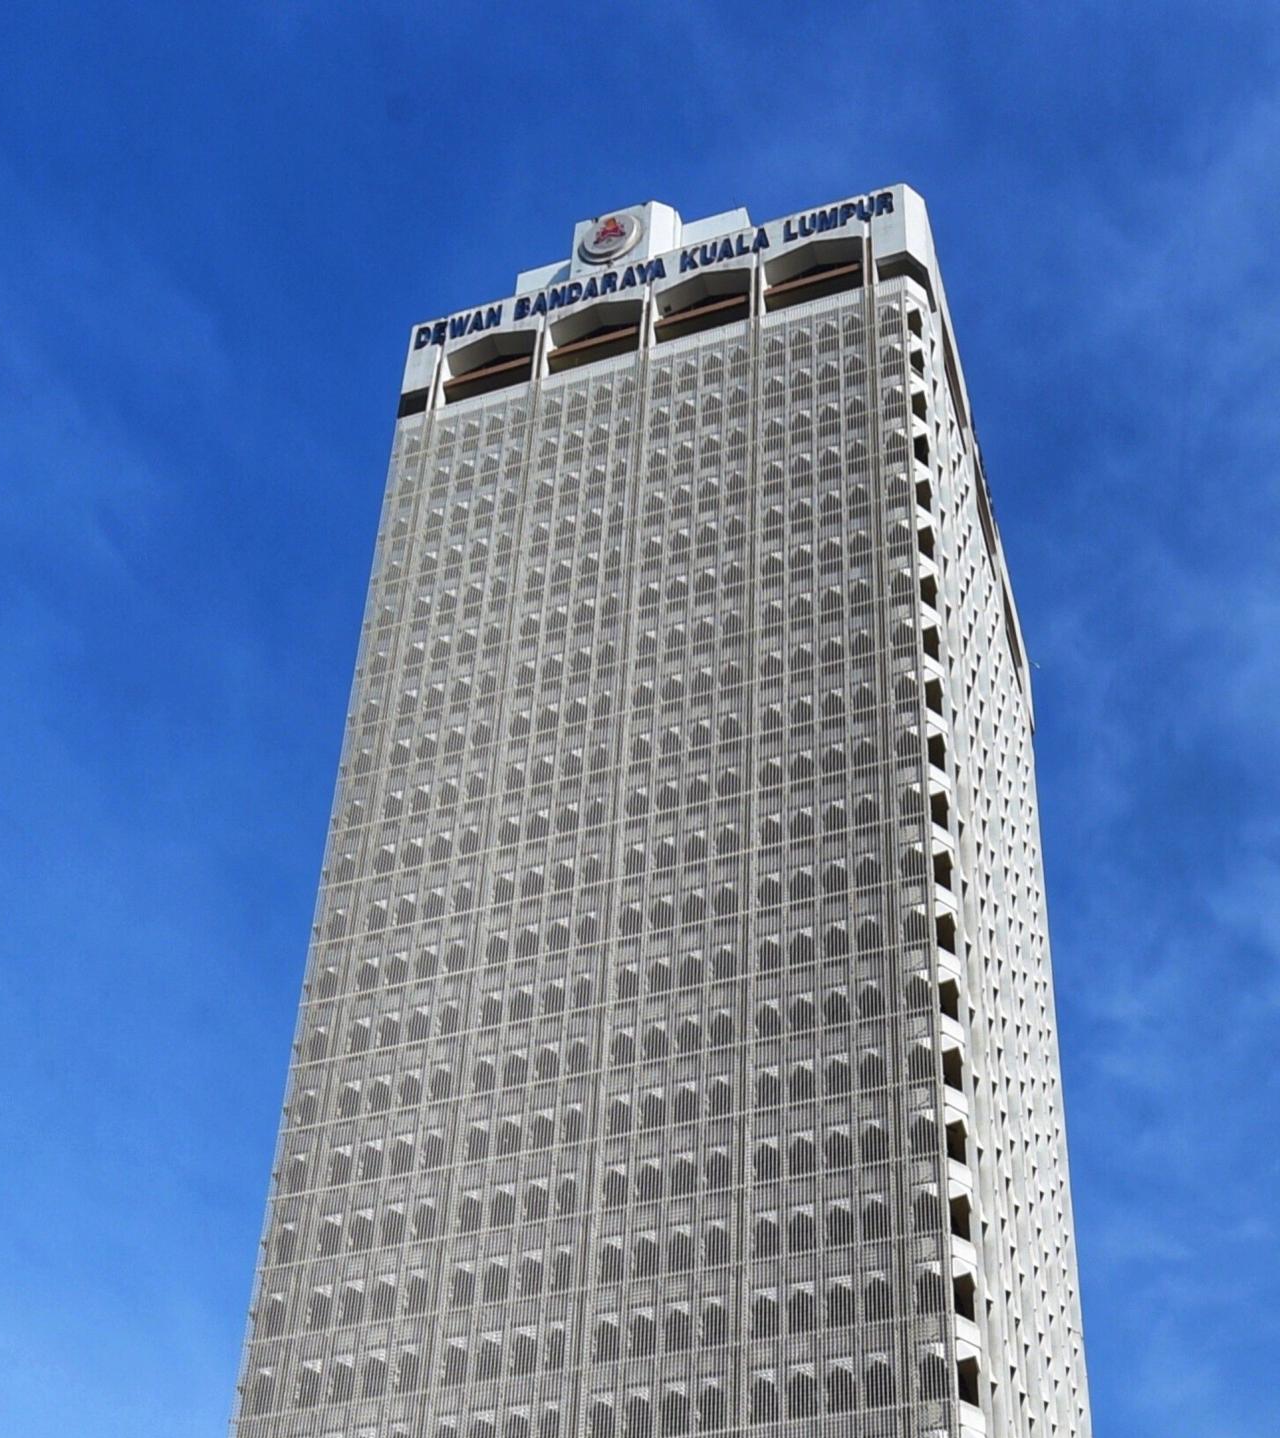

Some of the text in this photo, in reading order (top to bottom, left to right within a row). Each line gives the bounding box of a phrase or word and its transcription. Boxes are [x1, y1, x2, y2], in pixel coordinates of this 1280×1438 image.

[414, 191, 894, 350] DEWAN BANDARAYA KUALA LUMPUR
